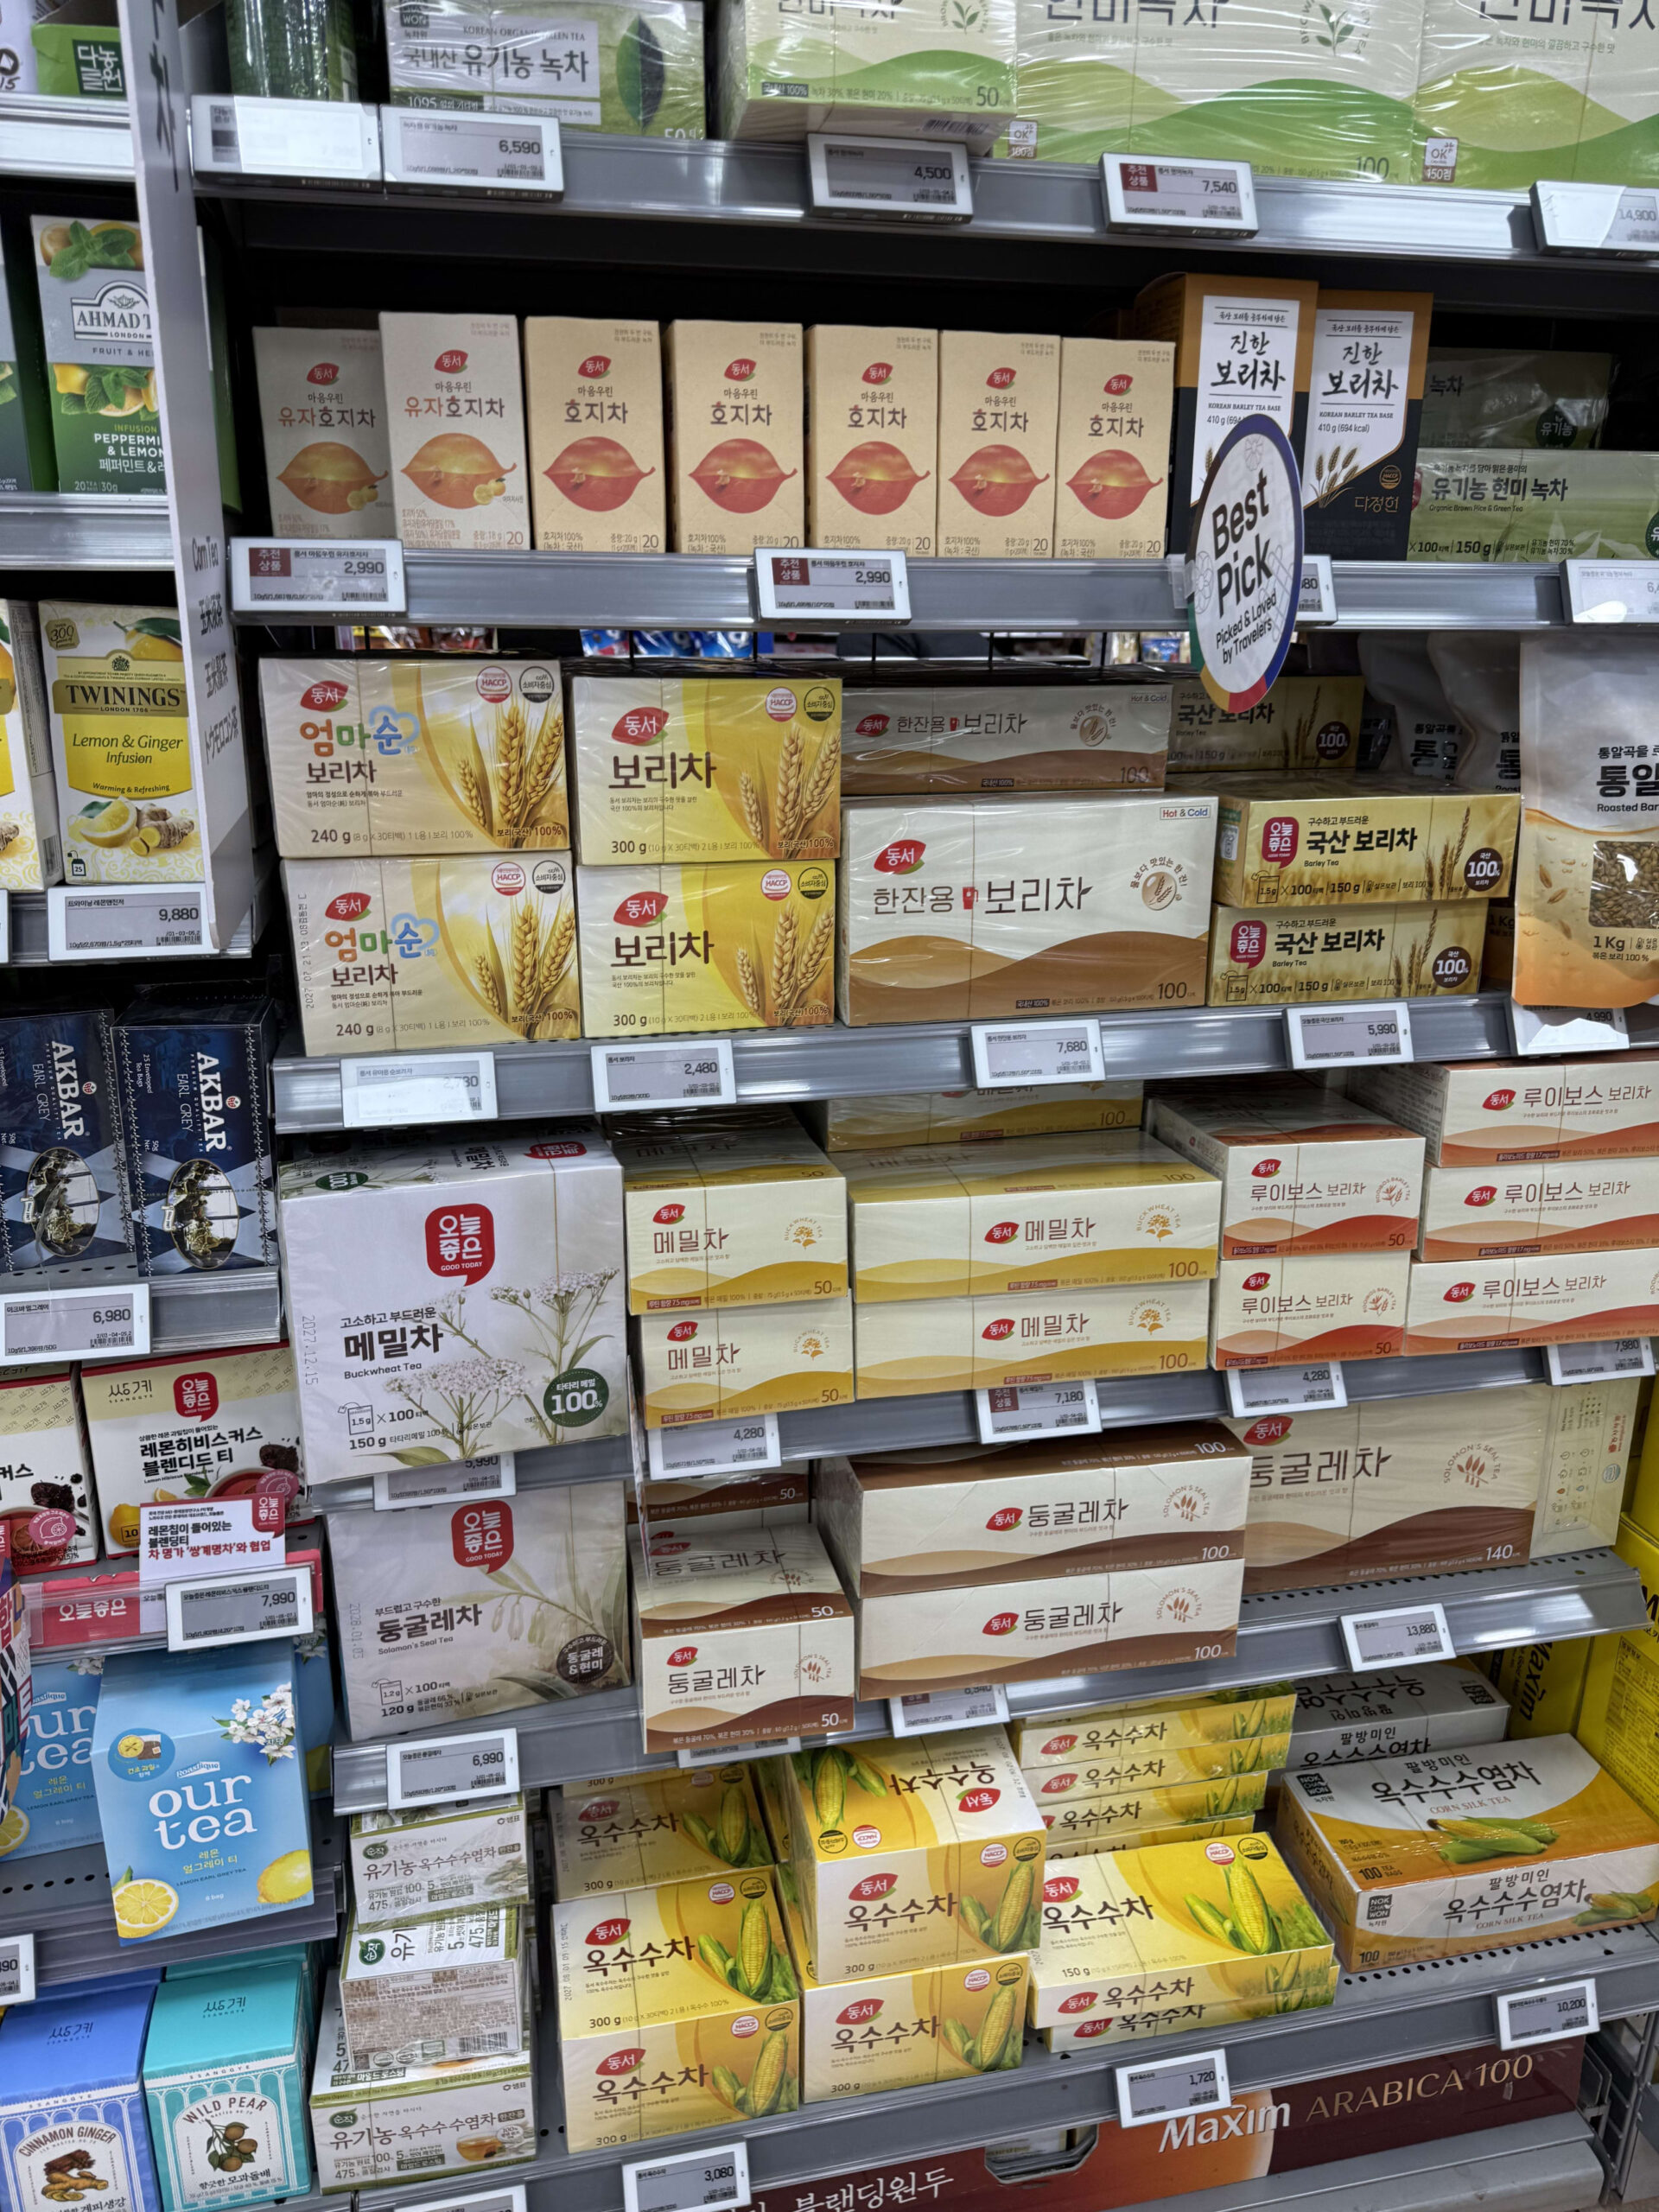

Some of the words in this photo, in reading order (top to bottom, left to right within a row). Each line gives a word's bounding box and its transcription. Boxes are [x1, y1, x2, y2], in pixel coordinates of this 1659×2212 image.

[403, 48, 457, 71] 국내산
[462, 44, 534, 79] 유기농
[540, 49, 589, 82] 녹차
[976, 86, 1000, 107] 50
[499, 139, 541, 156] 6,590
[914, 166, 952, 181] 4,500
[1128, 175, 1149, 188] 상품
[1202, 180, 1237, 194] 7,540
[1618, 209, 1656, 222] 14,900
[77, 310, 140, 329] AHMAD
[1343, 342, 1382, 365] 진한
[435, 381, 472, 394] 마음우린
[577, 386, 613, 398] 마음우린
[1322, 369, 1399, 399] 보리차
[1430, 376, 1464, 397] 녹차
[404, 395, 505, 420] 유자호지차
[564, 399, 628, 424] 호지차
[848, 405, 907, 429] 호지차
[113, 424, 157, 434] INFUSION
[1088, 415, 1144, 438] 호지차
[1431, 476, 1489, 501] 유기농
[1492, 477, 1527, 501] 현미
[1530, 478, 1569, 503] 녹차
[1211, 468, 1270, 561] Best
[344, 561, 385, 576] 2,990
[1216, 533, 1273, 619] Pick
[1216, 615, 1243, 651] Picked
[1243, 612, 1252, 628] &
[1252, 588, 1278, 624] Loved
[1222, 646, 1233, 664] by
[1233, 619, 1273, 657] Travelers
[481, 678, 506, 688] HACCP
[66, 684, 181, 708] TWININGS
[310, 688, 339, 705] 동서
[300, 715, 403, 757] 엄마순
[625, 716, 657, 735] 동서
[73, 733, 118, 748] Lemon
[122, 734, 135, 748] &
[137, 735, 183, 751] Ginger
[1598, 744, 1648, 761] 통알곡을
[106, 751, 152, 765] Infusion
[306, 760, 377, 785] 보리차
[608, 752, 717, 790] 보리차
[92, 782, 124, 794] Warming
[134, 783, 169, 794] Refreshing
[1162, 808, 1178, 818] Hot
[1187, 806, 1209, 817] Cold
[1597, 802, 1637, 813] Roasted
[496, 827, 532, 839] 보리(국산)
[534, 825, 563, 837] 100%
[1308, 817, 1336, 828] 구수하고
[1339, 815, 1369, 827] 부드러운
[311, 830, 338, 844] 240
[1306, 832, 1351, 855] 국산
[1354, 827, 1417, 853] 보리차
[612, 841, 634, 855] 300
[885, 846, 915, 865] 동서
[874, 885, 955, 915] 한잔용
[984, 876, 1093, 914] 보리차
[159, 907, 199, 922] 9,880
[611, 931, 715, 968] 보리차
[1273, 960, 1294, 969] Barley
[1295, 959, 1306, 968] Tea
[1158, 981, 1187, 1001] 100
[1368, 1023, 1397, 1036] 5,990
[1057, 1040, 1088, 1054] 7,680
[684, 1062, 717, 1077] 2,480
[51, 1039, 85, 1141] AKBAR
[176, 1073, 190, 1100] EARL
[1522, 1085, 1604, 1109] 루이보스
[1608, 1084, 1652, 1103] 보리차
[197, 1051, 227, 1154] AKBAR
[180, 1103, 193, 1133] GREY
[1250, 1181, 1323, 1204] 루이보스
[1327, 1181, 1366, 1198] 보리차
[1024, 1216, 1096, 1243] 메밀차
[654, 1227, 730, 1255] 메밀차
[441, 1263, 460, 1272] GOOD
[461, 1261, 482, 1269] TODAY
[1168, 1261, 1199, 1279] 100
[93, 1309, 130, 1325] 6,980
[340, 1312, 388, 1329] 고소하고
[391, 1306, 436, 1323] 부드러운
[344, 1323, 444, 1363] 메밀차
[345, 1363, 401, 1380] Buckwheat
[404, 1362, 422, 1371] Tea
[1302, 1370, 1330, 1382] 4,280
[1054, 1391, 1084, 1404] 7,180
[140, 1426, 264, 1459] 레몬히비스커스
[349, 1436, 374, 1451] 150
[734, 1427, 765, 1441] 4,280
[143, 1452, 213, 1478] 블렌디드
[217, 1447, 234, 1464] 티
[1027, 1498, 1129, 1529] 둥굴레차
[149, 1523, 189, 1537] 레몬칩이
[191, 1521, 232, 1535] 들어있는
[149, 1535, 189, 1548] 블렌딩티
[149, 1548, 159, 1560] 차
[162, 1547, 184, 1559] 명가
[249, 1539, 271, 1553] 협업
[1485, 1544, 1514, 1561] 140
[262, 1592, 296, 1607] 7,990
[375, 1603, 412, 1618] 부드럽고
[413, 1597, 442, 1611] 구수한
[60, 1599, 127, 1622] 오늘좋은
[376, 1603, 483, 1643] 둥굴레차
[1407, 1623, 1437, 1638] 13,880
[378, 1642, 418, 1656] Solomon's
[420, 1638, 437, 1649] Seal
[438, 1636, 454, 1646] Tea
[667, 1664, 766, 1694] 둥굴레차
[1082, 1721, 1166, 1752] 옥수수차
[473, 1751, 504, 1768] 6,990
[1405, 1753, 1472, 1775] 팔방미인
[1371, 1759, 1541, 1808] 옥수수수염차
[149, 1773, 252, 1818] our
[1430, 1802, 1461, 1815] CORN
[1464, 1800, 1486, 1812] SILK
[1488, 1796, 1510, 1807] TEA
[154, 1807, 257, 1850] tea
[183, 1858, 224, 1875] 얼그레이
[227, 1854, 238, 1865] 티
[199, 1849, 219, 1860] 레몬
[363, 1859, 415, 1882] 유기농
[418, 1847, 495, 1873] 옥수수수염차
[1443, 1878, 1587, 1924] 옥수수수염차
[844, 1892, 958, 1933] 옥수수차
[1042, 1895, 1154, 1935] 옥수수차
[583, 1935, 695, 1977] 옥수수차
[1557, 1998, 1586, 2014] 10,200
[589, 2017, 611, 2030] 300
[1189, 2071, 1216, 2086] 1,720
[1306, 2071, 1465, 2123] ARABICA
[1474, 2053, 1534, 2087] 100
[182, 2099, 221, 2126] WILD
[229, 2095, 268, 2113] PEAR
[329, 2126, 397, 2155] 유기농
[398, 2111, 496, 2142] 옥수수수염차
[1159, 2101, 1292, 2153] Maxim
[19, 2126, 74, 2158] CINNAMON
[77, 2126, 117, 2145] GINGER
[200, 2177, 226, 2192] 향긋한
[227, 2167, 271, 2188] 모과돌배
[704, 2166, 734, 2183] 3,080
